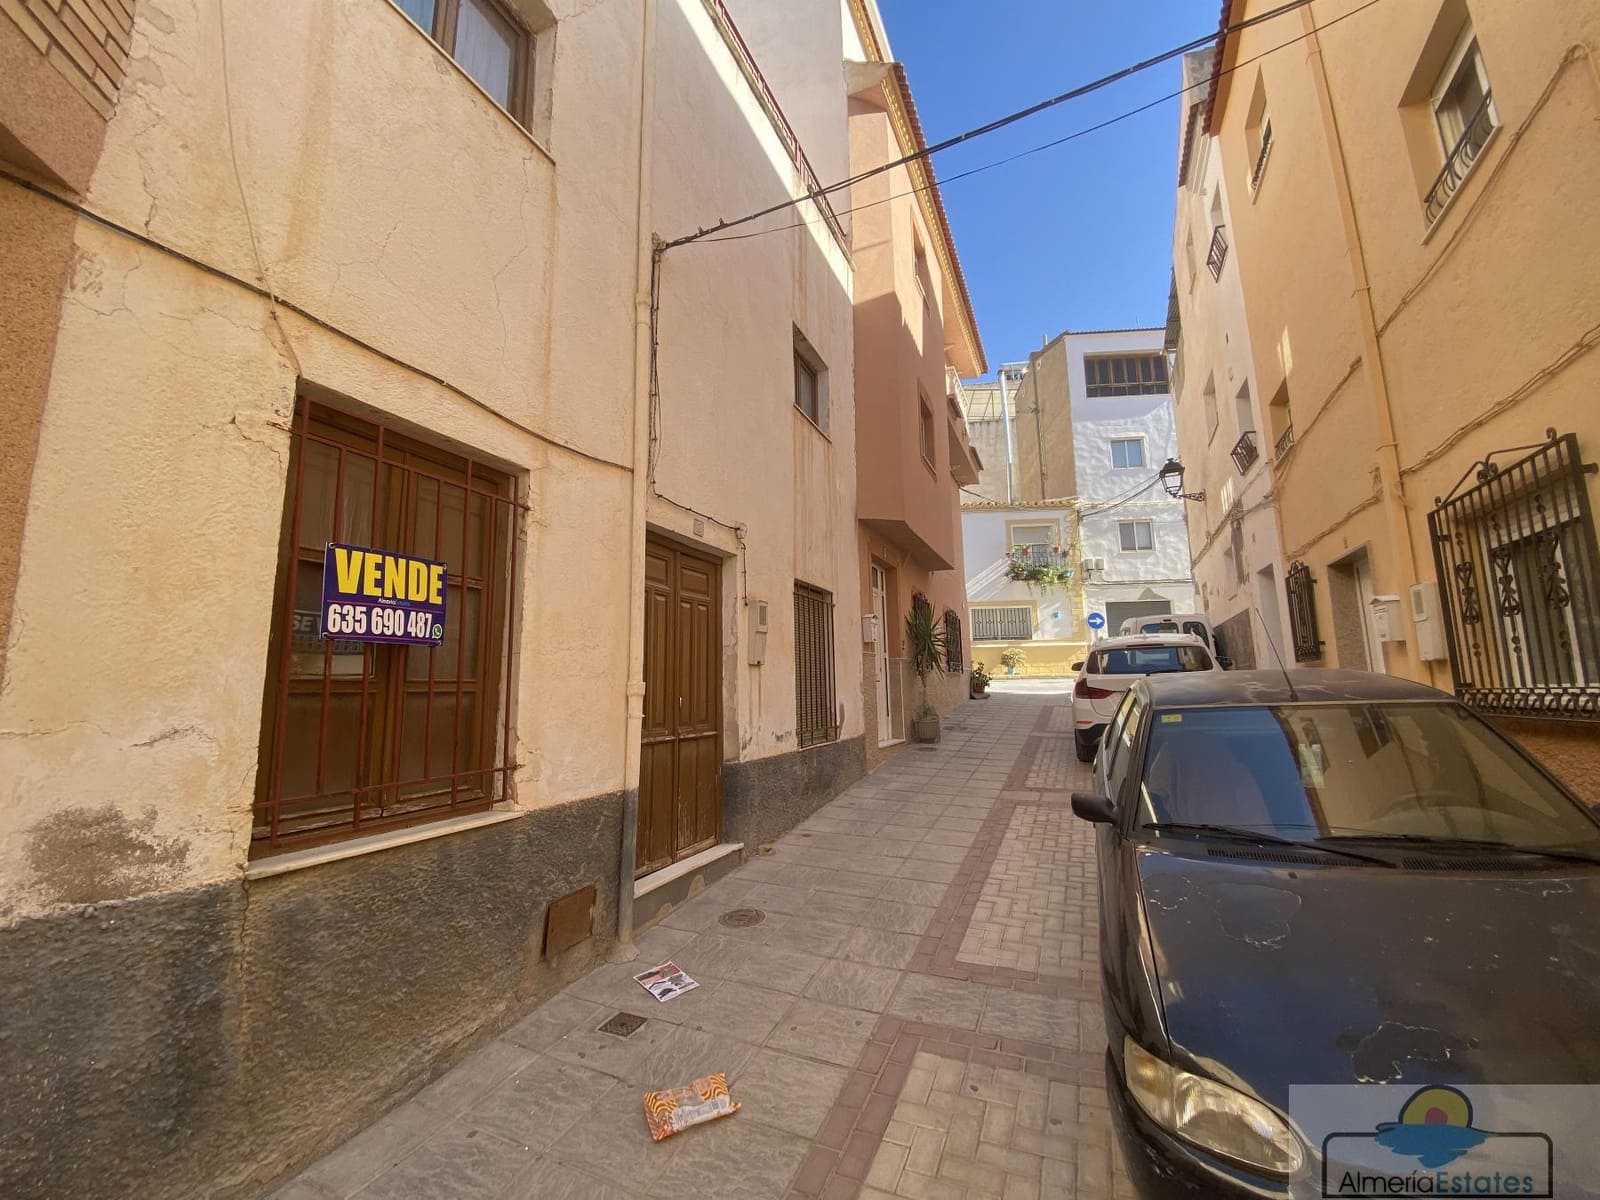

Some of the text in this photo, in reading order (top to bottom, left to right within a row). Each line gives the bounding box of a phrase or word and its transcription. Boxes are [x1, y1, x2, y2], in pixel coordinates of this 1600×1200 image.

[335, 548, 443, 605] VENDE
[327, 603, 367, 634] 635
[371, 607, 405, 636] 690
[407, 611, 432, 638] 487
